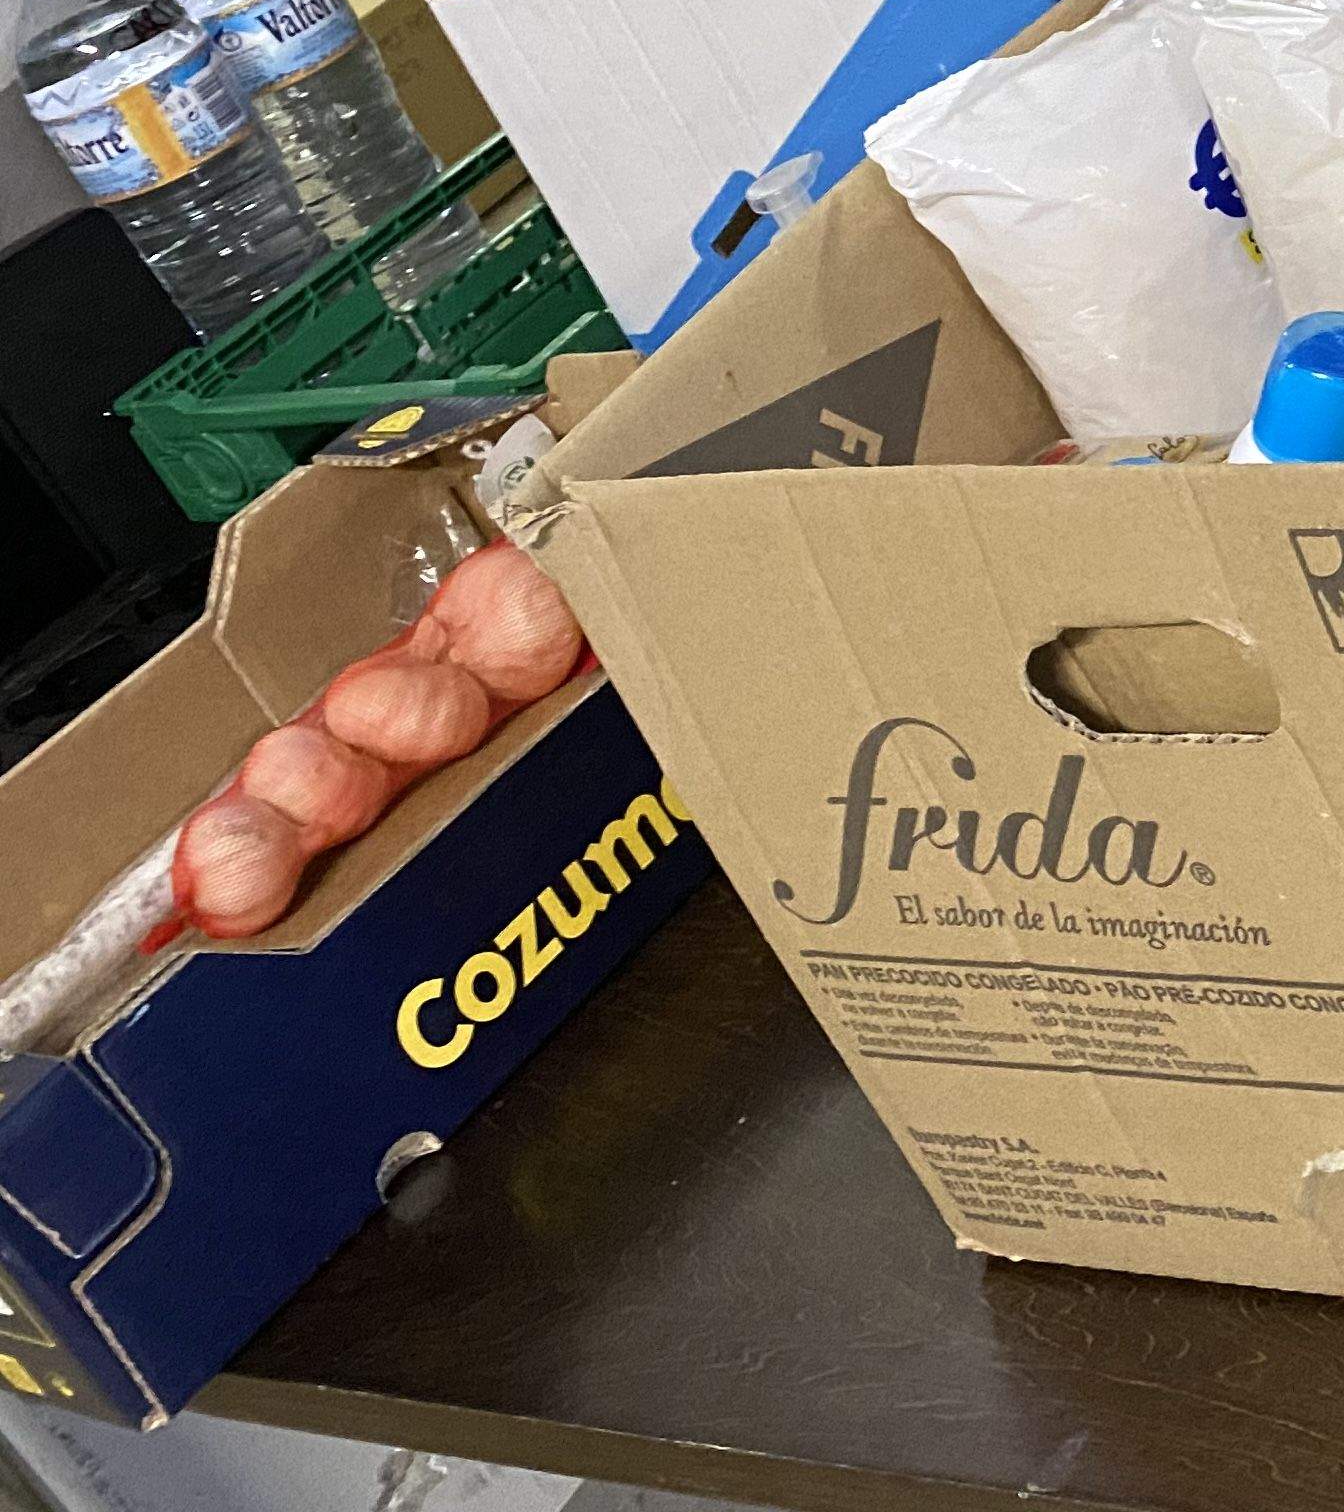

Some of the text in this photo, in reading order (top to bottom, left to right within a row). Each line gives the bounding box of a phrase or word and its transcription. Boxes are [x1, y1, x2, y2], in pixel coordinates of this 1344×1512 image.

[894, 894, 1273, 951] El sabor de la imaginación
[806, 962, 848, 981] PAN
[851, 966, 964, 989] PRECOCIDO
[963, 971, 1094, 997] CONGELADO
